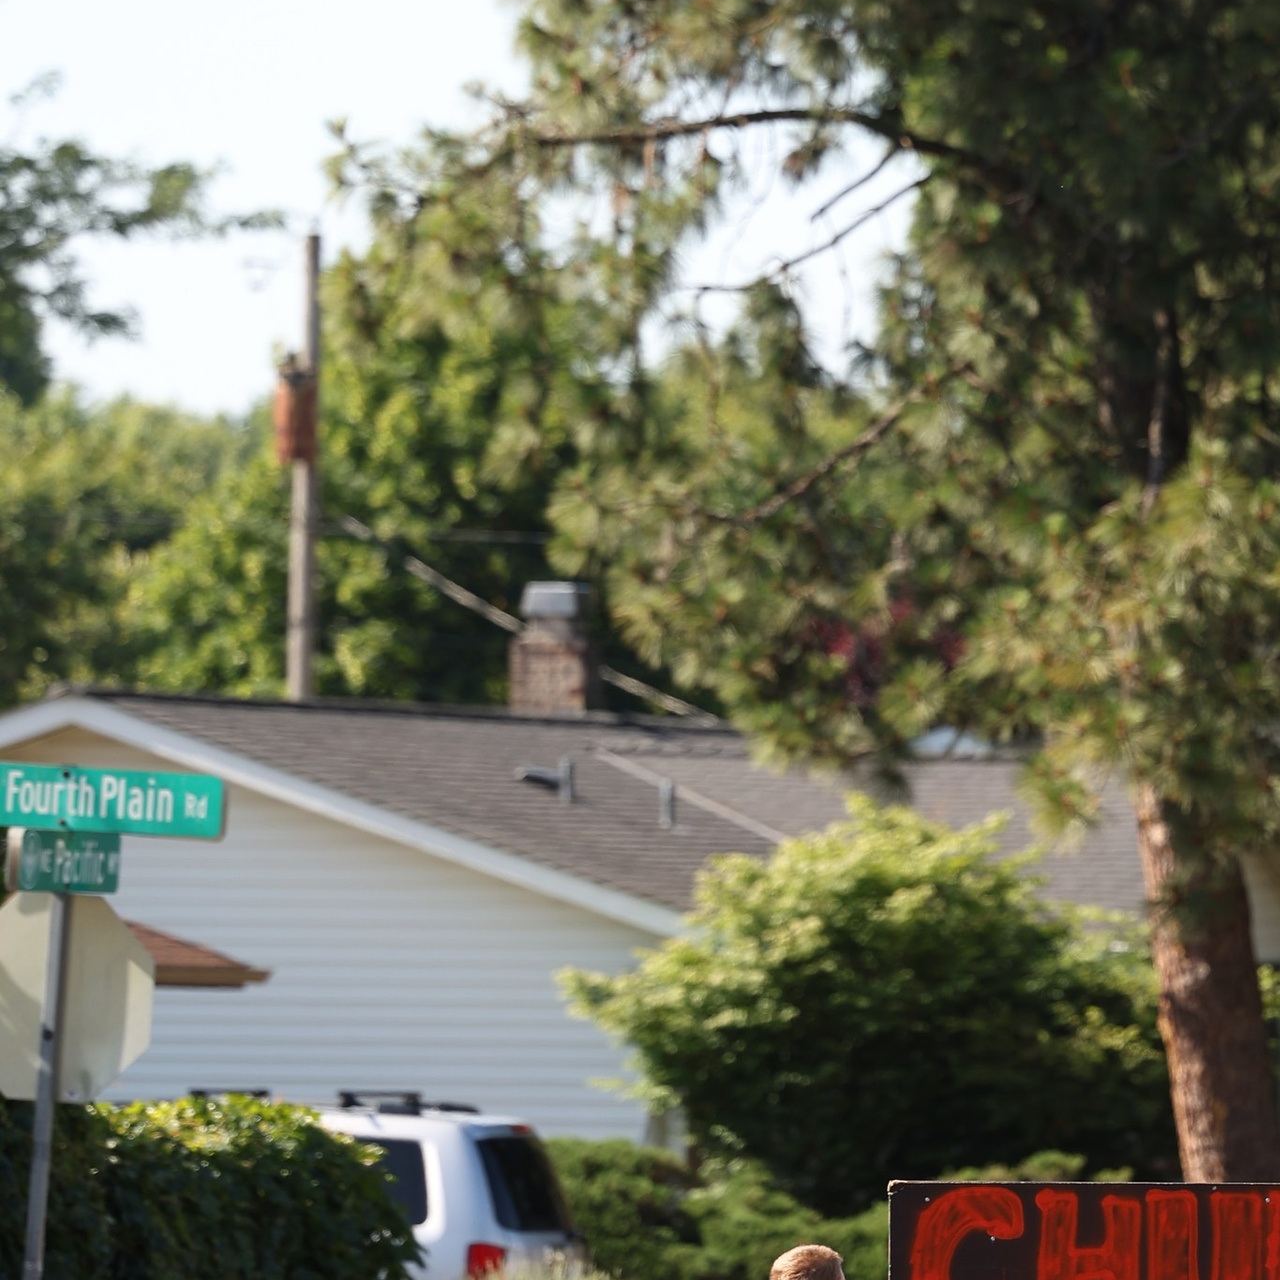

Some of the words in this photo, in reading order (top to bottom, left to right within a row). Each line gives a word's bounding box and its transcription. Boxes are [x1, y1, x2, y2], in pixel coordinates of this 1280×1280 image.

[6, 770, 95, 818] Fourth
[100, 775, 173, 823] Plain
[184, 792, 209, 820] Rd
